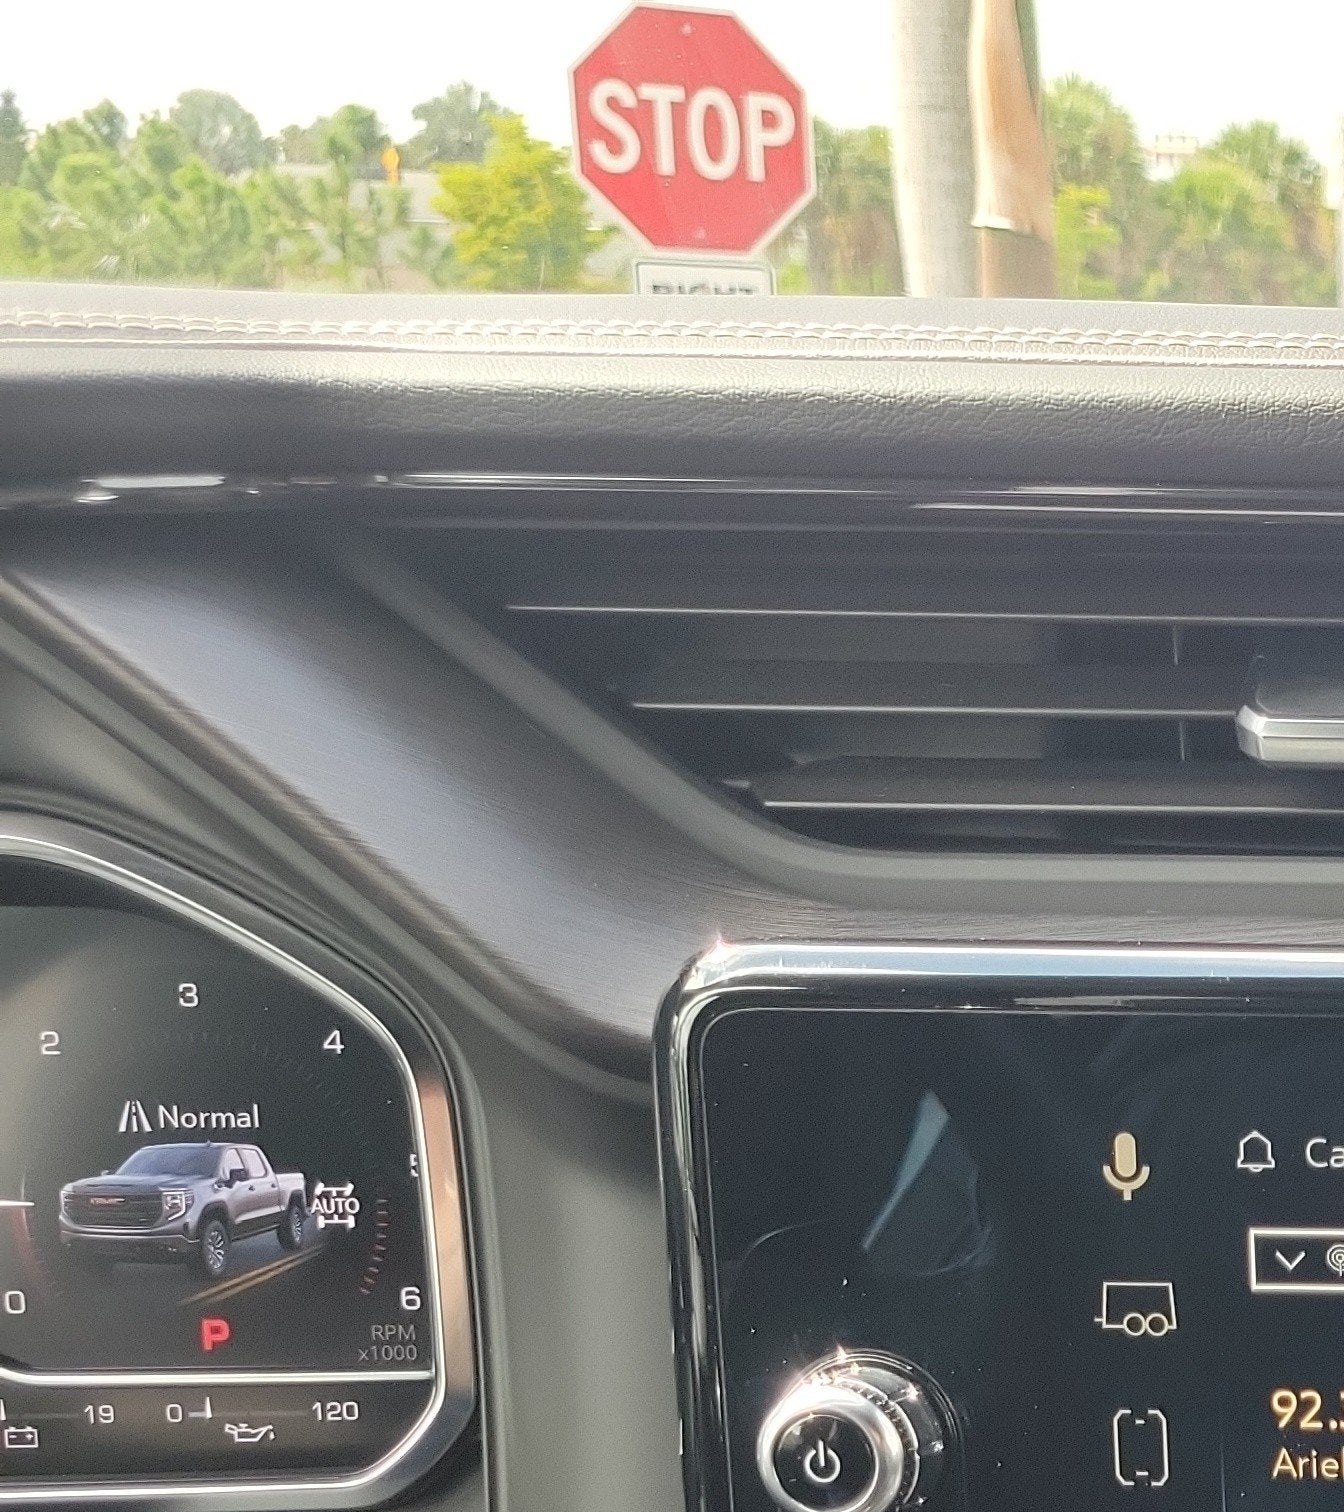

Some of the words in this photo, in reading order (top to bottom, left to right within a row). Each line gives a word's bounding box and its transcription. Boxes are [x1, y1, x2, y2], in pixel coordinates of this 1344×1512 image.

[588, 77, 796, 183] STOP
[178, 982, 199, 1008] 3
[39, 1030, 61, 1055] 2
[322, 1029, 345, 1055] 4
[158, 1103, 260, 1129] Normal
[310, 1197, 360, 1216] AUTO
[4, 1290, 26, 1315] 0
[400, 1286, 421, 1312] 6
[201, 1318, 230, 1350] P
[371, 1323, 416, 1341] RPM
[358, 1346, 417, 1362] x1000
[84, 1404, 115, 1425] 19
[165, 1403, 183, 1423] 0
[312, 1401, 359, 1421] 120
